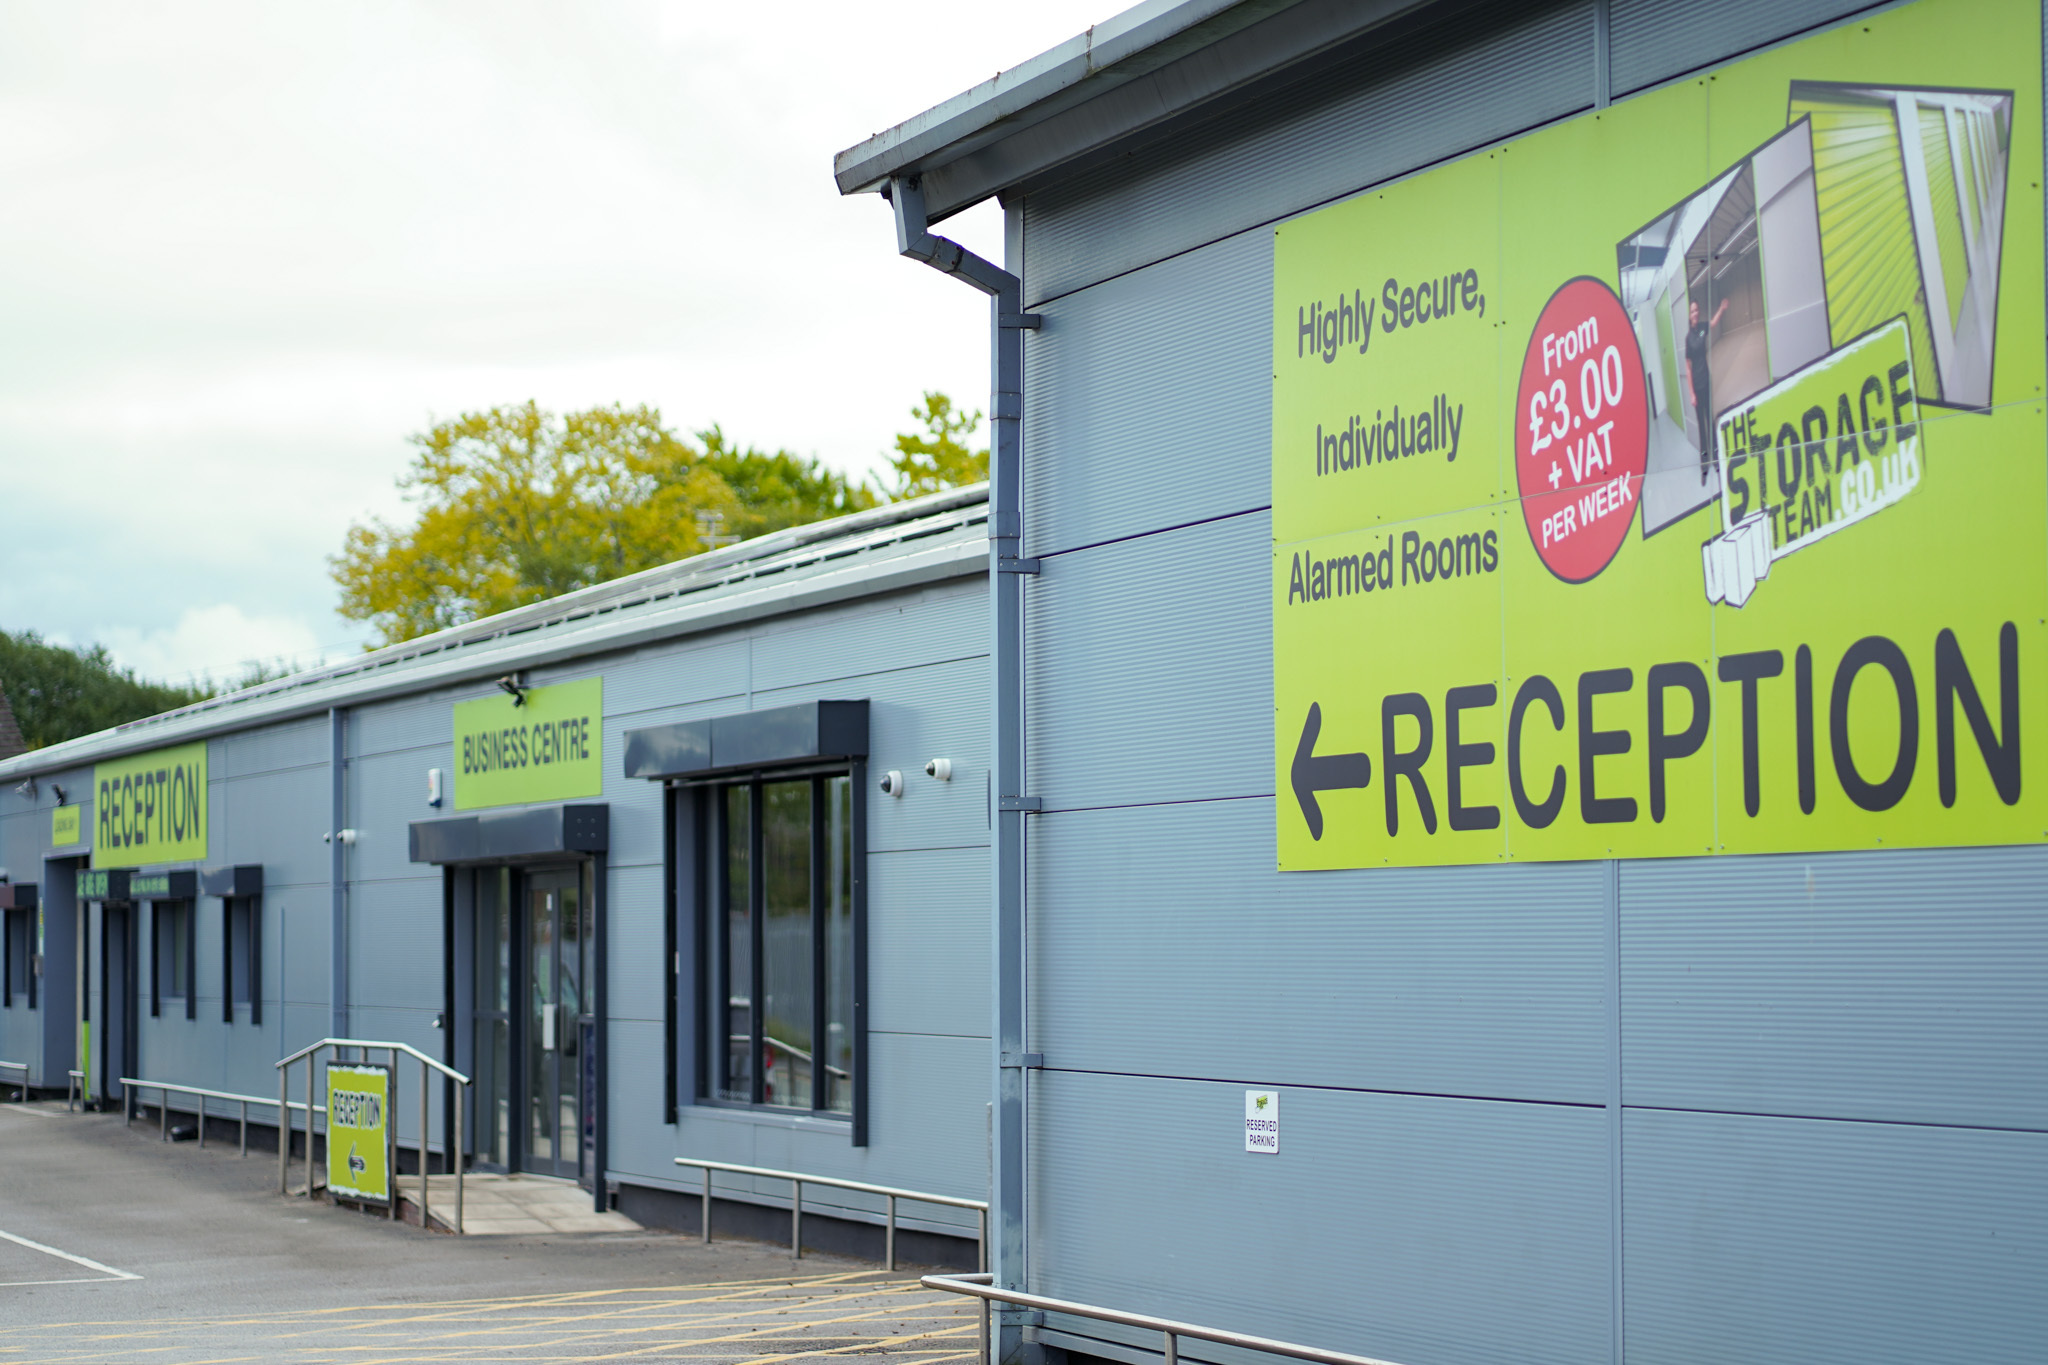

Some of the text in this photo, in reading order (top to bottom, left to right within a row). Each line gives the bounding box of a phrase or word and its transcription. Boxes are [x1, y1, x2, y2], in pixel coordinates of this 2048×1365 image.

[1298, 267, 1486, 364] Highly Secure,
[1542, 315, 1599, 376] From
[1315, 392, 1464, 477] Individually
[1529, 344, 1624, 456] £3.00
[1720, 404, 1757, 457] THE
[1548, 420, 1615, 490] + VAT
[1726, 360, 1918, 527] STORAGE
[1541, 470, 1633, 549] PER WEEK
[1288, 529, 1499, 607] Alarmed Rooms
[463, 716, 589, 775] BUSINESS CENTRE
[1381, 620, 2022, 837] RECEPTION
[100, 762, 199, 849] RECEPTION
[333, 1088, 381, 1130] RECEPTION
[1246, 1119, 1277, 1132] RESERVED
[1249, 1134, 1275, 1147] PARKING
